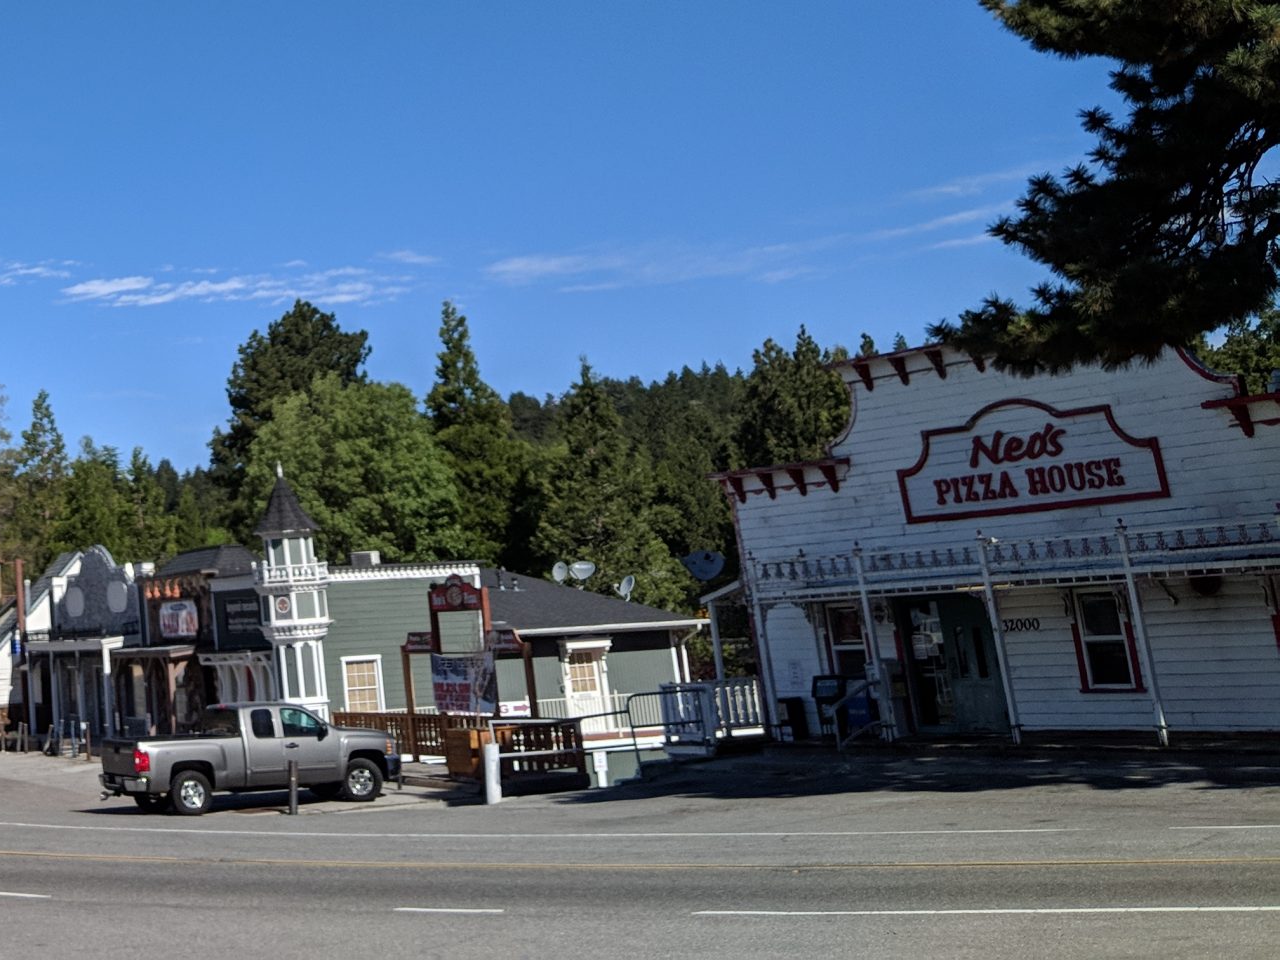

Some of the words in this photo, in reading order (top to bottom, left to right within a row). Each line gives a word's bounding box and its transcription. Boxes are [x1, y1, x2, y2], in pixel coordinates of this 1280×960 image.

[970, 423, 1066, 468] Ned's
[933, 471, 1019, 505] PIZZA
[1025, 458, 1125, 496] HOUSE
[1002, 617, 1040, 633] 32000
